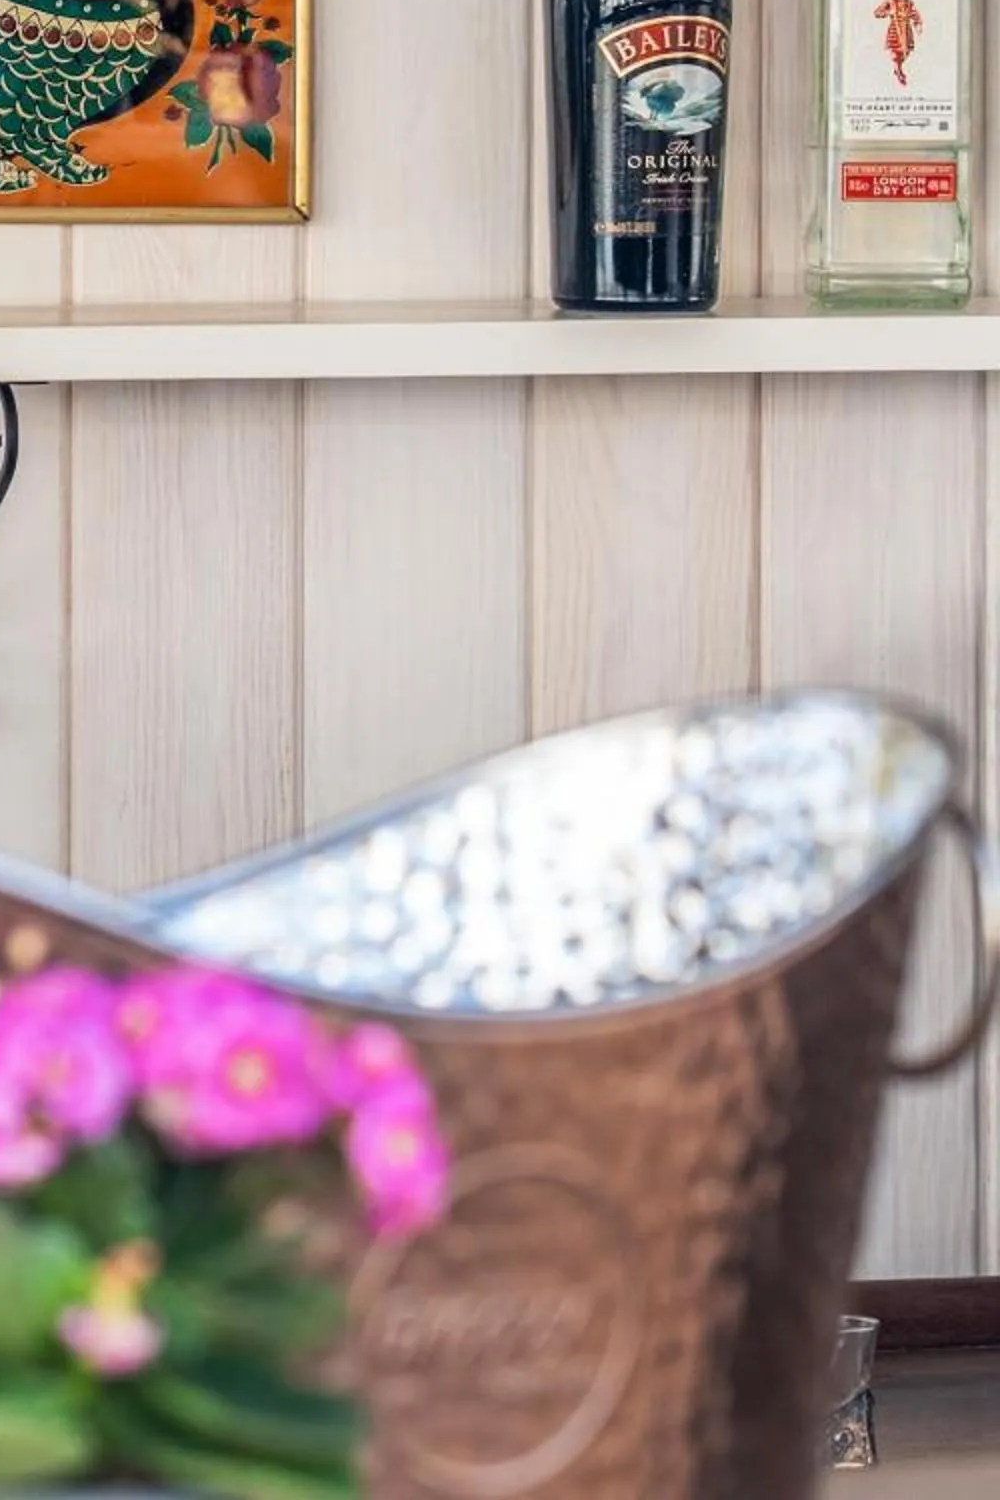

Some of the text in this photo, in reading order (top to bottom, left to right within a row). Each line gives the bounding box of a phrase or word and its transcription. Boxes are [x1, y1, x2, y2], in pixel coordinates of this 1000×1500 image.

[615, 25, 726, 62] BAILEYS
[627, 155, 718, 168] ORIGINAL
[873, 177, 926, 186] LONDON
